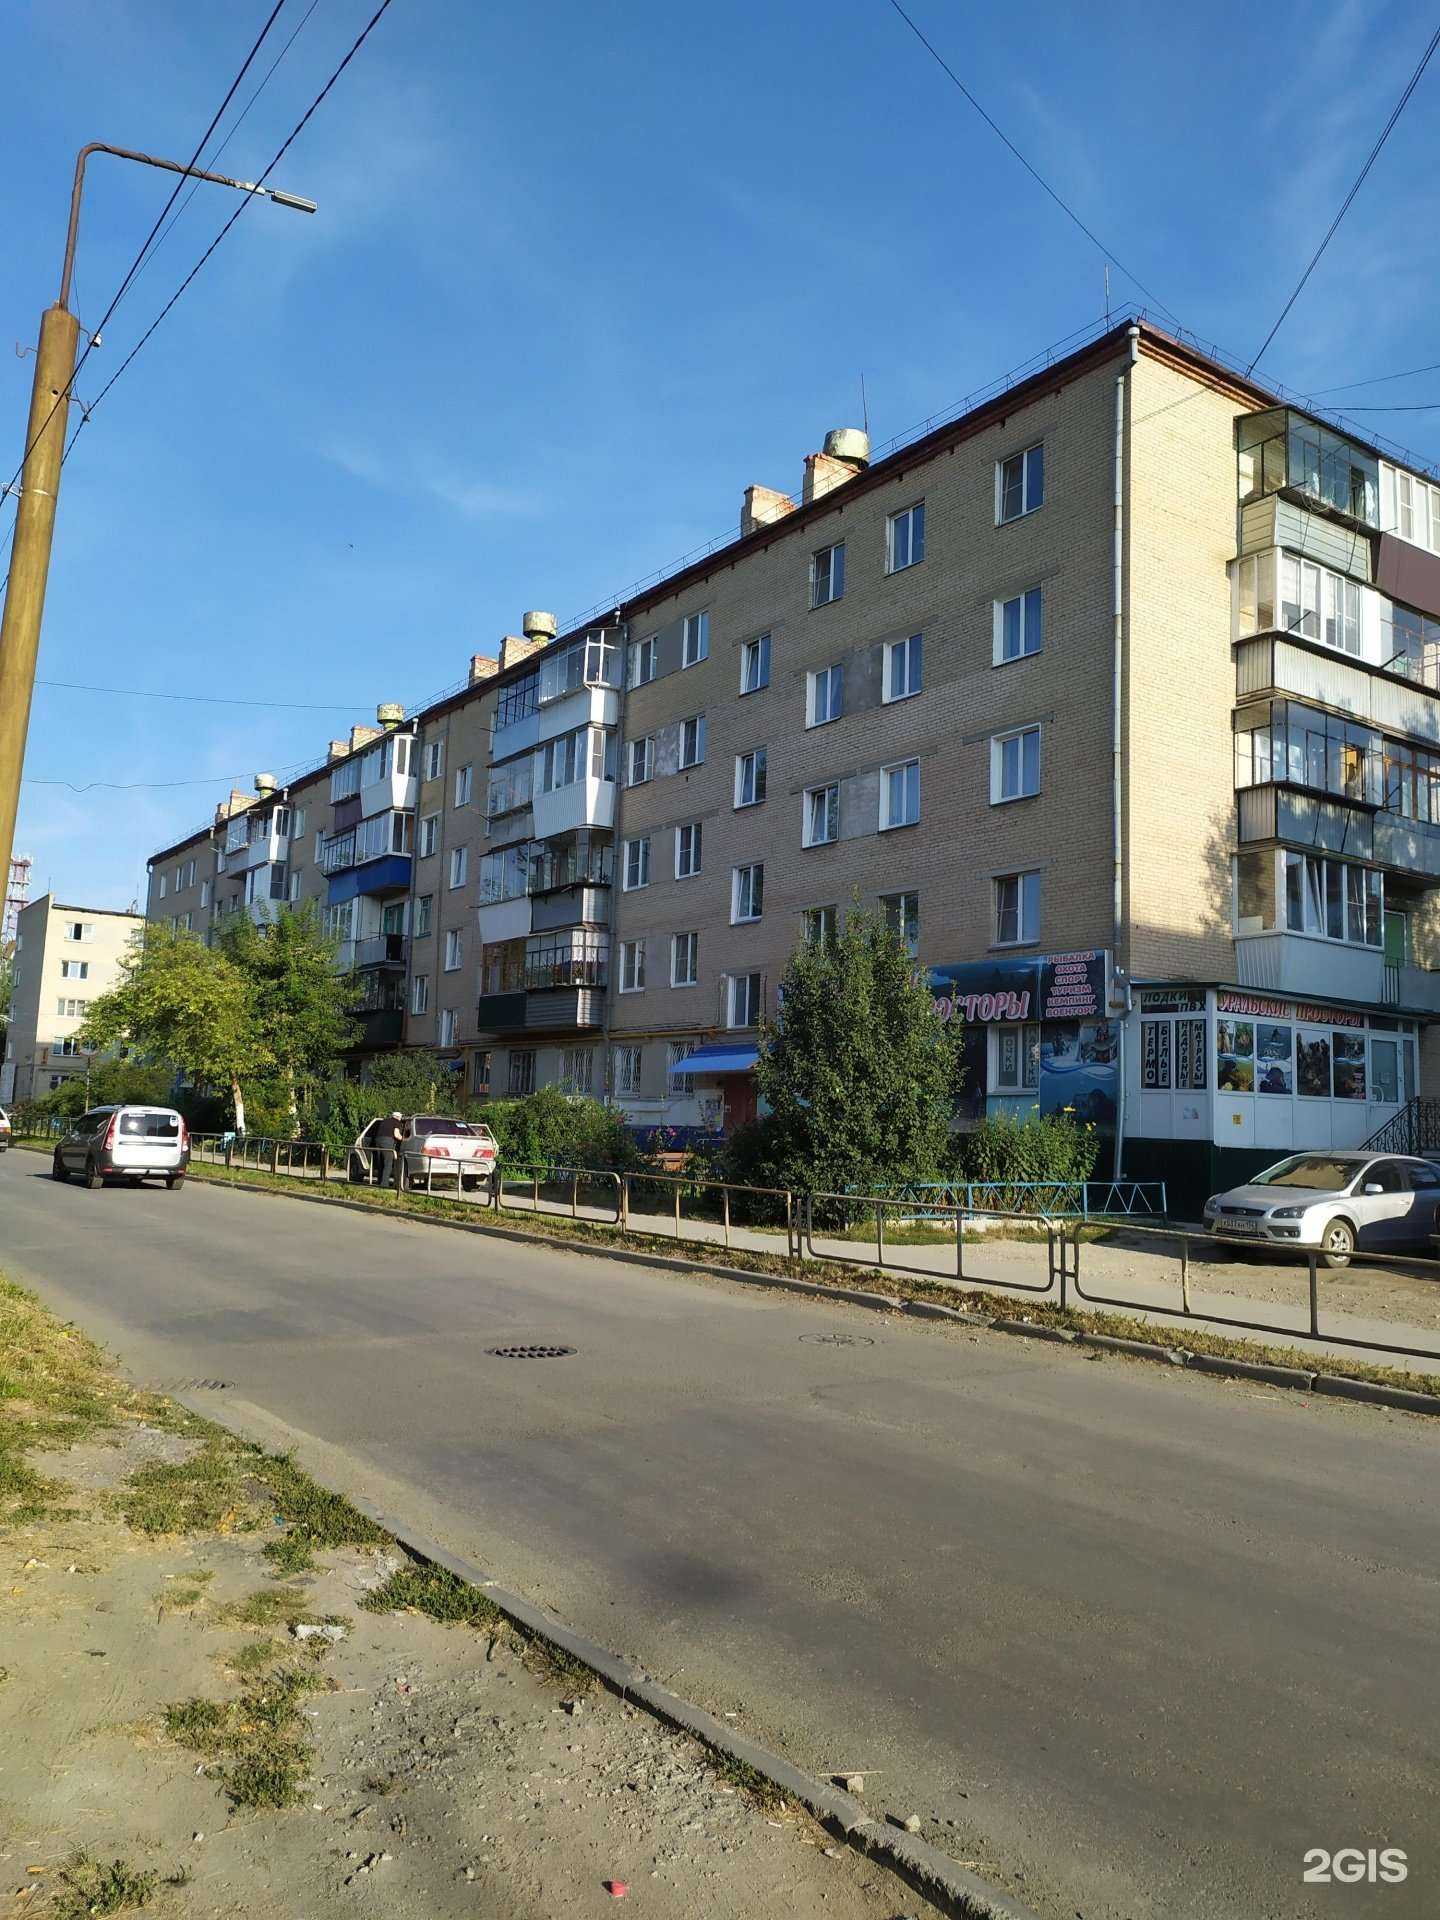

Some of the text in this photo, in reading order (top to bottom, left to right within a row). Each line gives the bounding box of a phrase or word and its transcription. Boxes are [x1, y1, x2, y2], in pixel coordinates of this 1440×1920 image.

[1055, 963, 1088, 975] ОХОТА
[1055, 974, 1088, 985] СПОРТ
[1050, 984, 1092, 996] ТУРИЗМ
[1047, 995, 1096, 1007] КЕМПИНГ
[1143, 992, 1187, 1005] ЛОДКИ
[1046, 1005, 1097, 1017] ВОЕНТОРГ
[1180, 1002, 1205, 1012] ПВХ
[1219, 992, 1290, 1018] УРАЛЬСКИЕ
[1005, 1038, 1013, 1071] ОЧКИ
[1145, 1027, 1155, 1080] ТЕРМО
[1179, 1022, 1189, 1087] НАДУВНЫЕ
[1193, 1024, 1203, 1080] МАТРАСЫ
